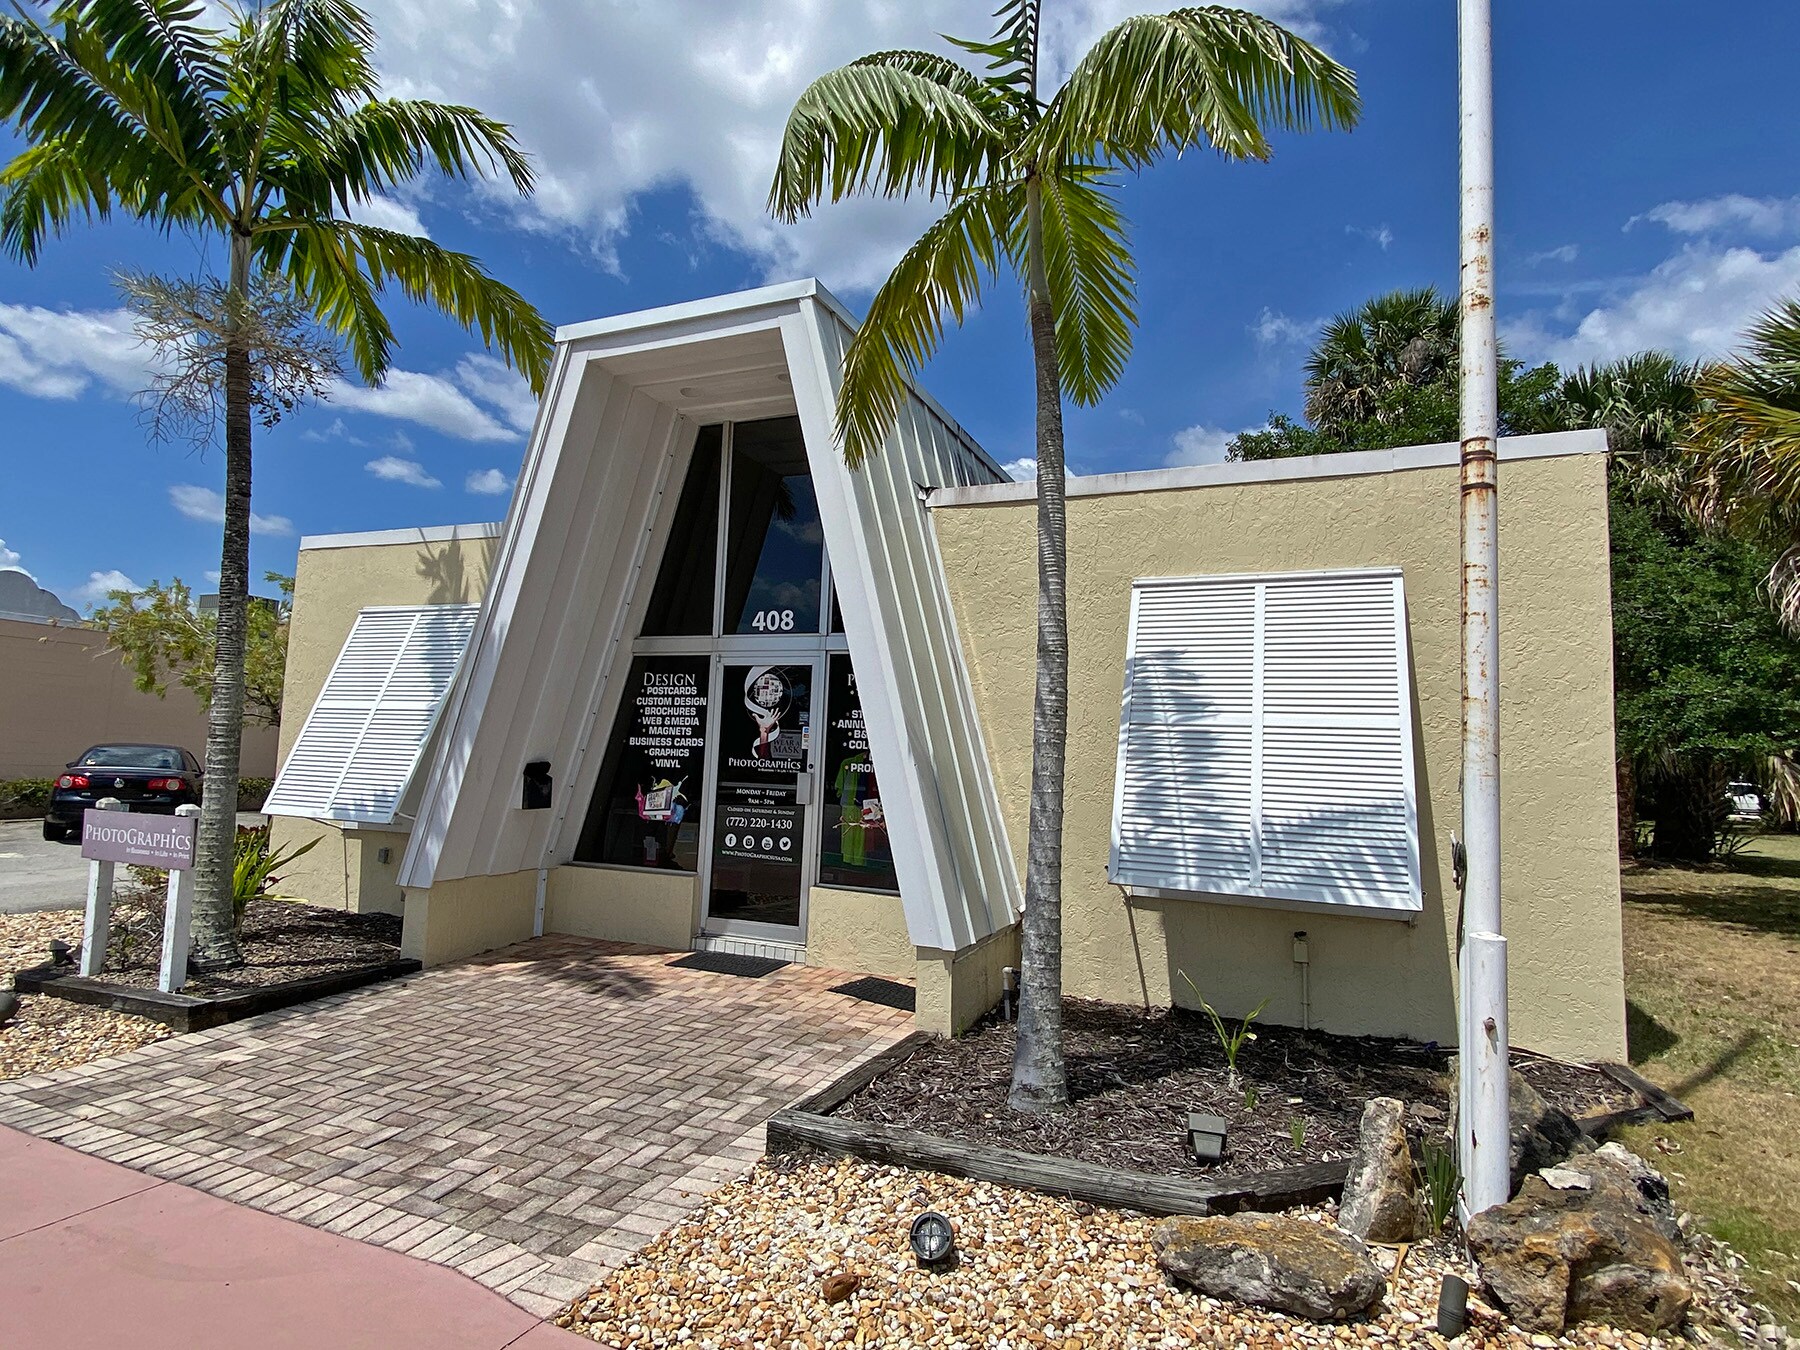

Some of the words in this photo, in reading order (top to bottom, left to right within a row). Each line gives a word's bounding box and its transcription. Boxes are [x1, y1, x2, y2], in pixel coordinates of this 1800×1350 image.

[752, 610, 794, 631] 408
[643, 672, 696, 686] DESIGN
[646, 686, 698, 695] POSTCARDS
[636, 697, 672, 706] CUSTOM
[674, 697, 707, 706] DESIGN
[644, 707, 697, 716] BROCHURES
[851, 710, 864, 719] ST
[642, 717, 663, 725] WEB
[837, 719, 866, 729] ANNU
[648, 726, 692, 736] MAGNETS
[853, 729, 868, 739] B&
[629, 737, 672, 746] BUSINESS
[674, 738, 704, 747] CARDS
[848, 740, 870, 750] COL
[648, 748, 690, 757] GRAPHICS
[773, 745, 800, 754] MASK
[655, 759, 681, 768] VINYL
[850, 763, 875, 773] PRO
[736, 788, 761, 796] MONDAY
[765, 789, 787, 797] FRIDAY
[726, 817, 748, 827] (772)
[750, 817, 793, 830] 220-1430
